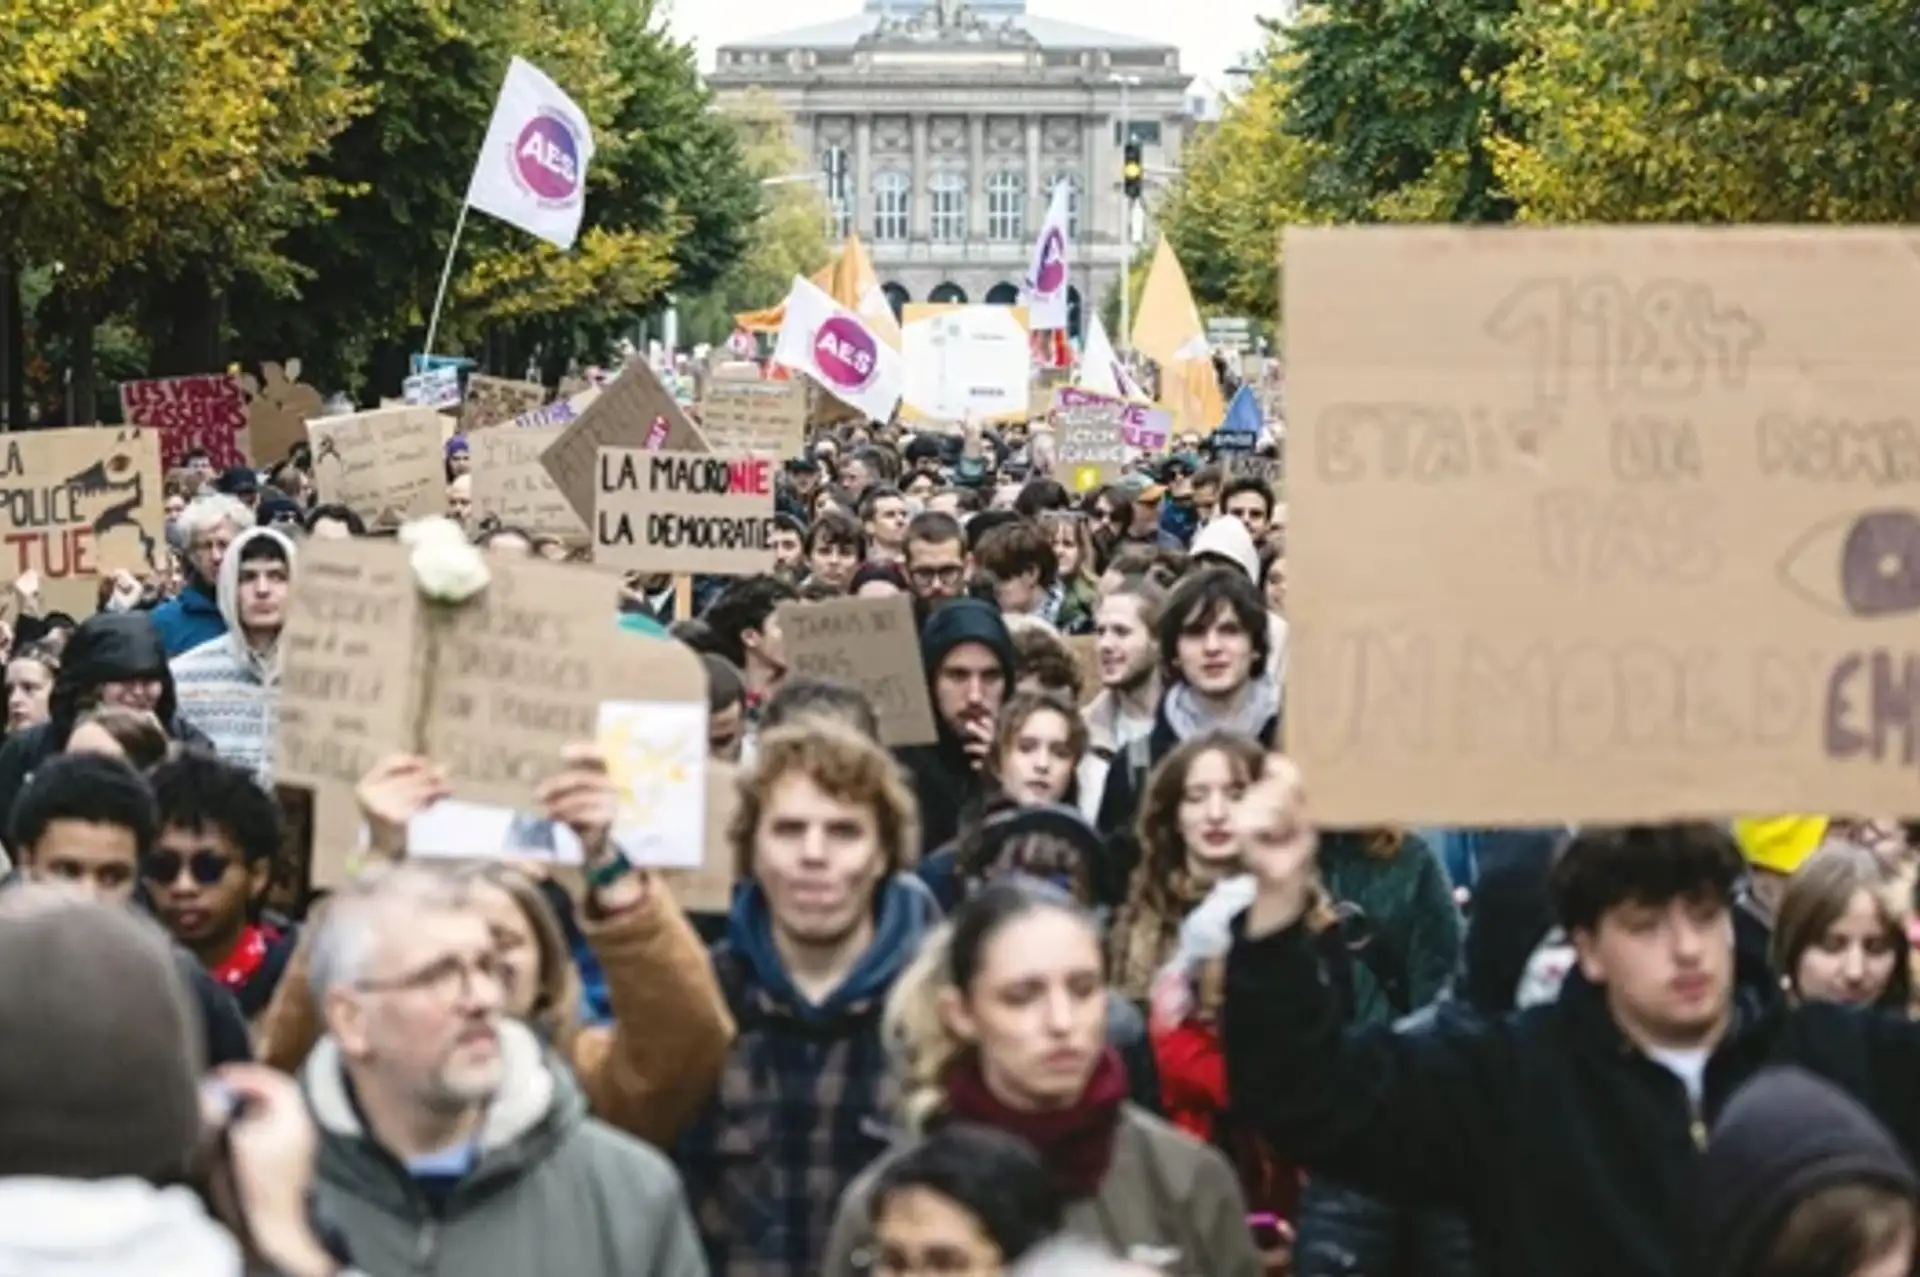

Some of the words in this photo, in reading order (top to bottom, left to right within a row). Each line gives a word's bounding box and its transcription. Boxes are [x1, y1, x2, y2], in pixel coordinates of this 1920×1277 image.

[520, 131, 577, 184] AES
[816, 331, 871, 375] AES
[1482, 271, 1767, 402] 1984
[0, 440, 23, 477] A
[602, 453, 638, 491] LA
[651, 455, 769, 494] MACRONIE
[599, 513, 634, 545] LA
[4, 527, 97, 578] TUE
